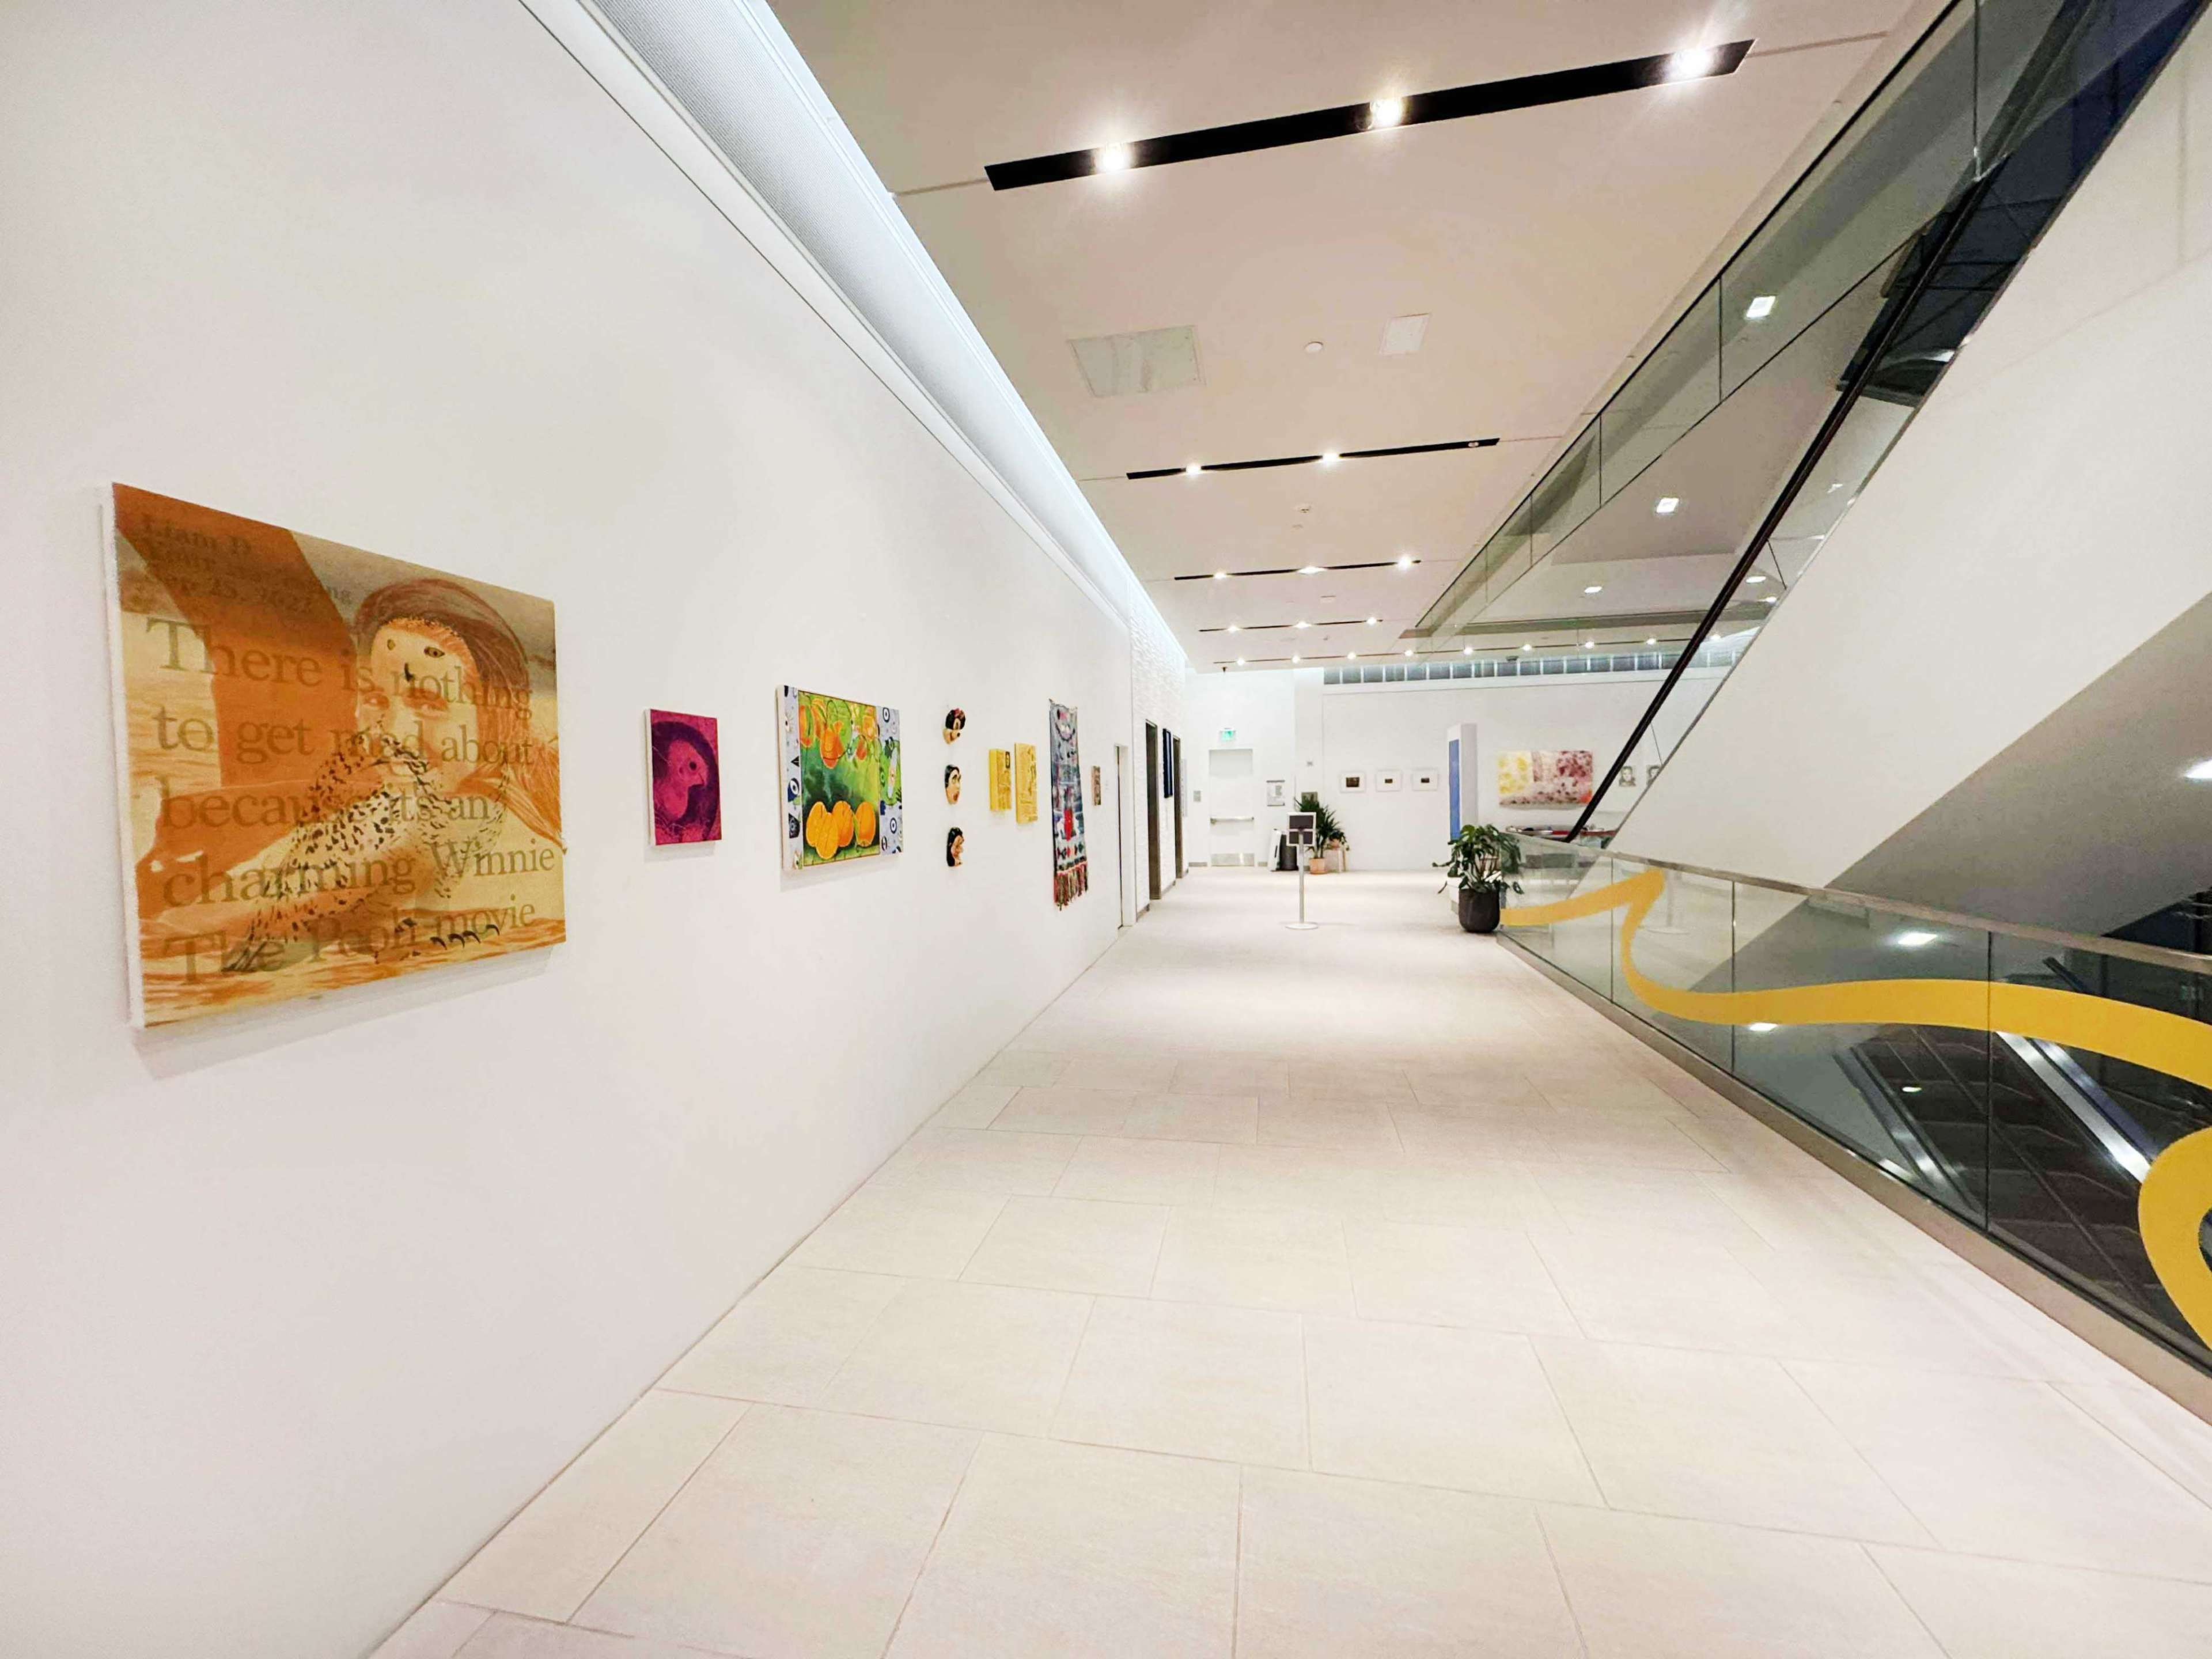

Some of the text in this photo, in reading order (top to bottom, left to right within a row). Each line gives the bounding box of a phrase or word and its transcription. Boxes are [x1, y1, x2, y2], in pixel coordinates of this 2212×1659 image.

[147, 616, 533, 720] There is nothing
[152, 704, 215, 752] to
[236, 718, 316, 765] get
[441, 724, 533, 764] about
[449, 793, 492, 820] an
[162, 838, 555, 908] charming Winnie
[435, 893, 536, 938] movie
